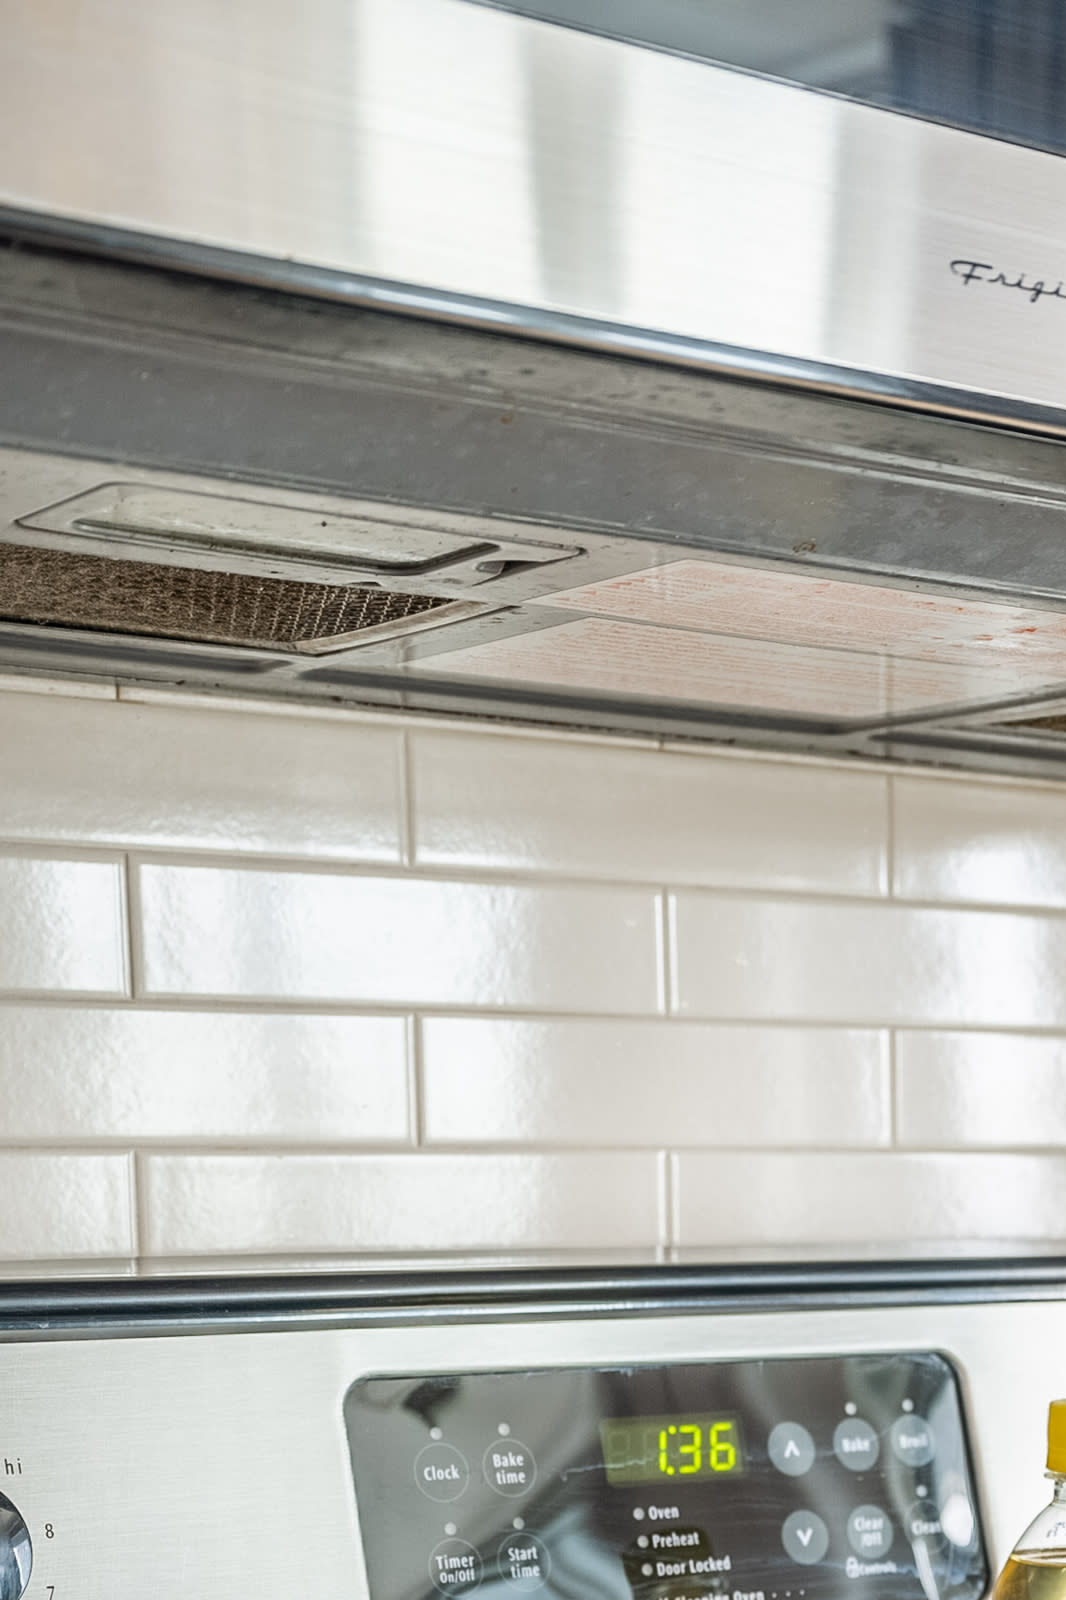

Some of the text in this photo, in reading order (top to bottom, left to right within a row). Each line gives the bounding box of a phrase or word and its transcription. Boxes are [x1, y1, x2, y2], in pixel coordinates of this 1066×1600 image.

[4, 1458, 22, 1476] hi
[492, 1452, 525, 1468] Bake
[423, 1464, 460, 1481] Clock
[496, 1470, 526, 1485] time
[648, 1506, 680, 1520] Oven
[44, 1523, 55, 1539] 8
[652, 1531, 700, 1549] Preheat
[435, 1554, 475, 1570] Timer
[507, 1546, 538, 1562] Start
[511, 1563, 541, 1579] time
[656, 1555, 732, 1577] Door Locked
[440, 1567, 476, 1584] On/Off
[46, 1585, 55, 1600] 7
